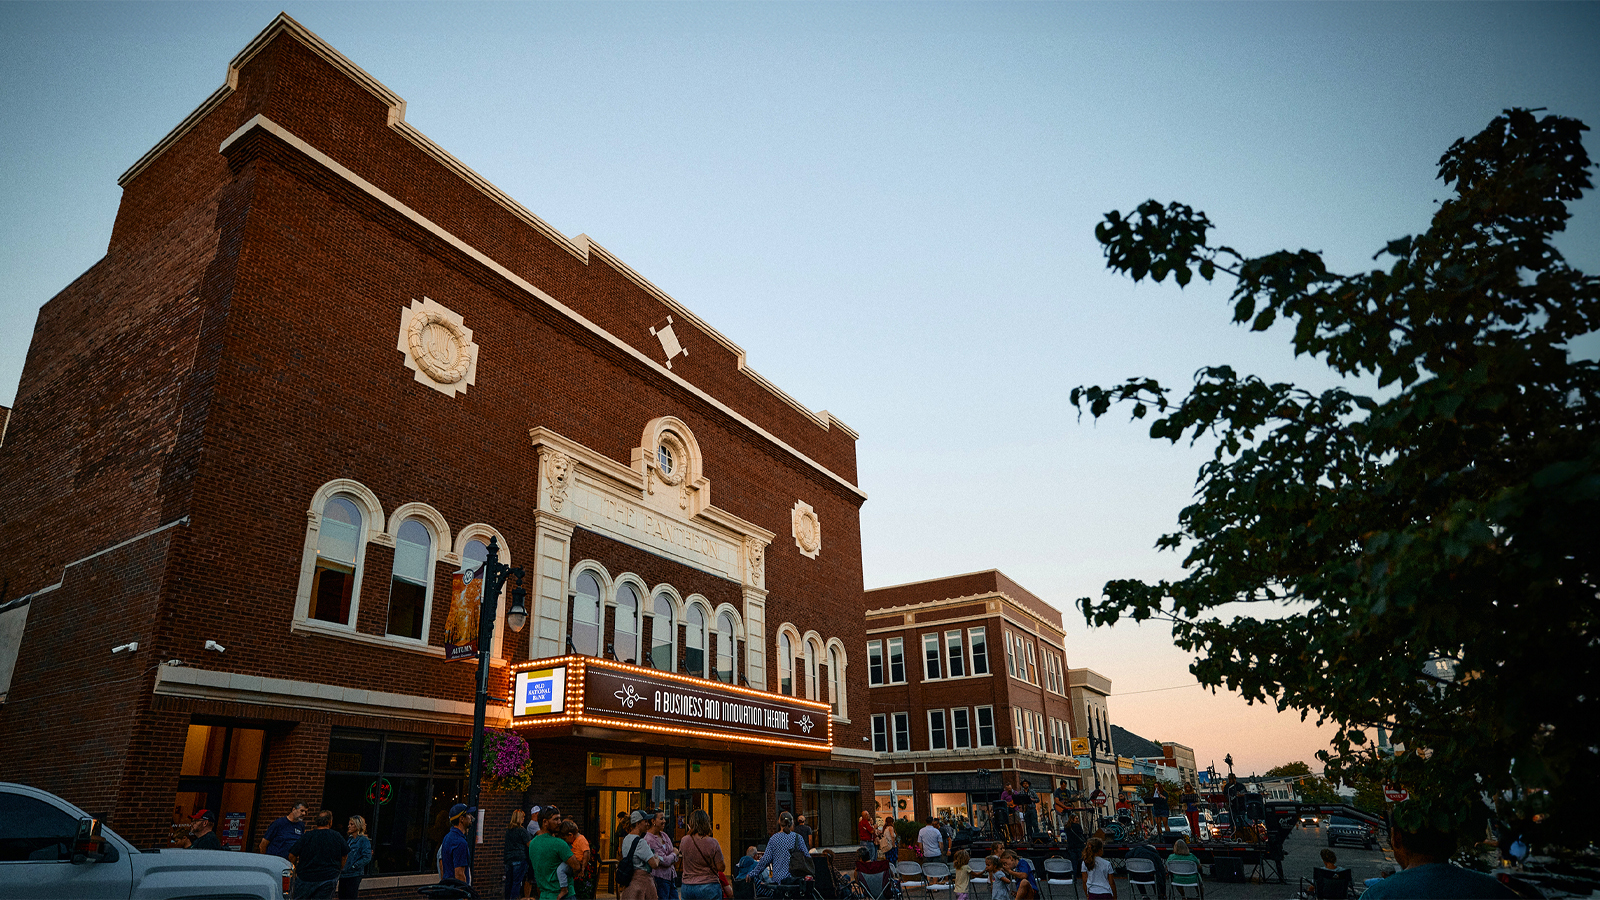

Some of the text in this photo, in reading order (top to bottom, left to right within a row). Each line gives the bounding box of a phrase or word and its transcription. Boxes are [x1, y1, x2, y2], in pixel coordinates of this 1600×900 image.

[604, 498, 719, 560] THE PANTHEON
[528, 688, 551, 696] NATIONAL
[654, 690, 789, 730] A BUSINESS AND INNOVATION THEATRE
